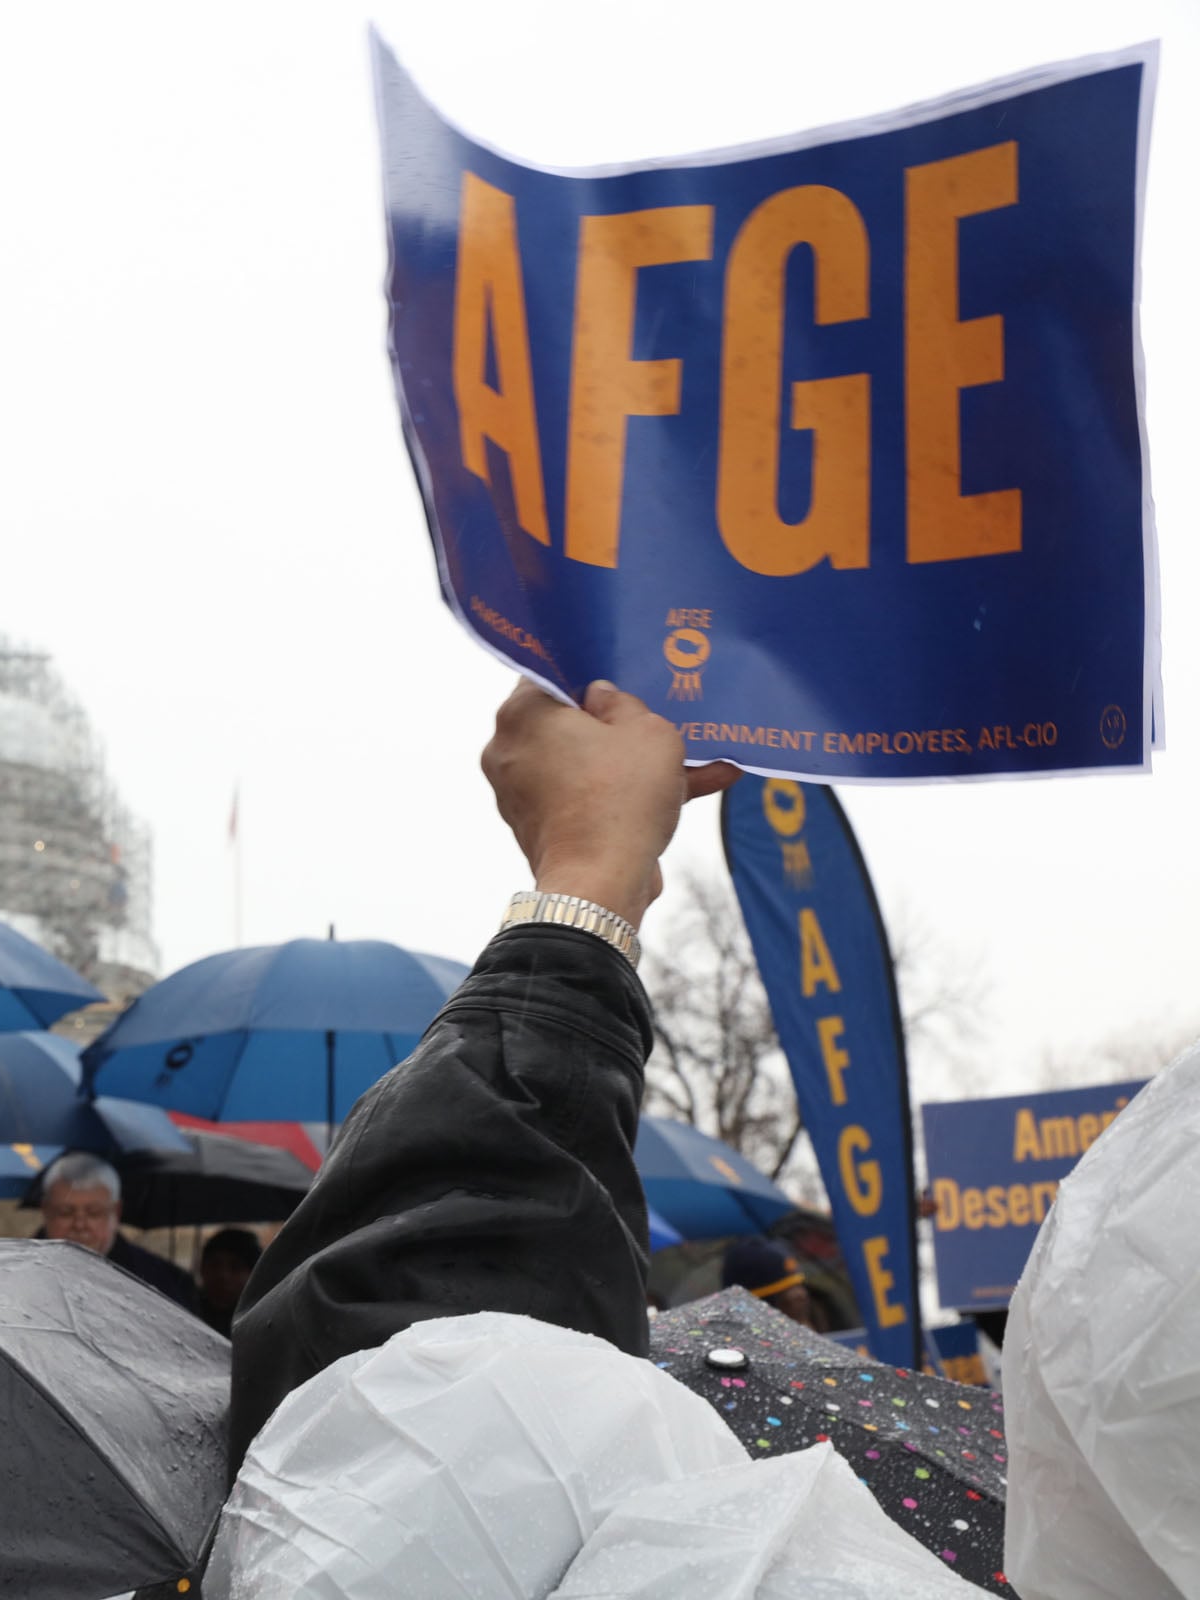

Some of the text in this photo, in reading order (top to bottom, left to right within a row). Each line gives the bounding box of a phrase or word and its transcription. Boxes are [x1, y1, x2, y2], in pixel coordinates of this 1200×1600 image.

[453, 142, 1021, 576] AFGE
[676, 721, 1058, 755] ERNMENT EMPLOYEES, AFL-CIO
[798, 908, 906, 1328] AFGE
[1013, 1097, 1128, 1164] Ame
[933, 1178, 1058, 1232] Deser
